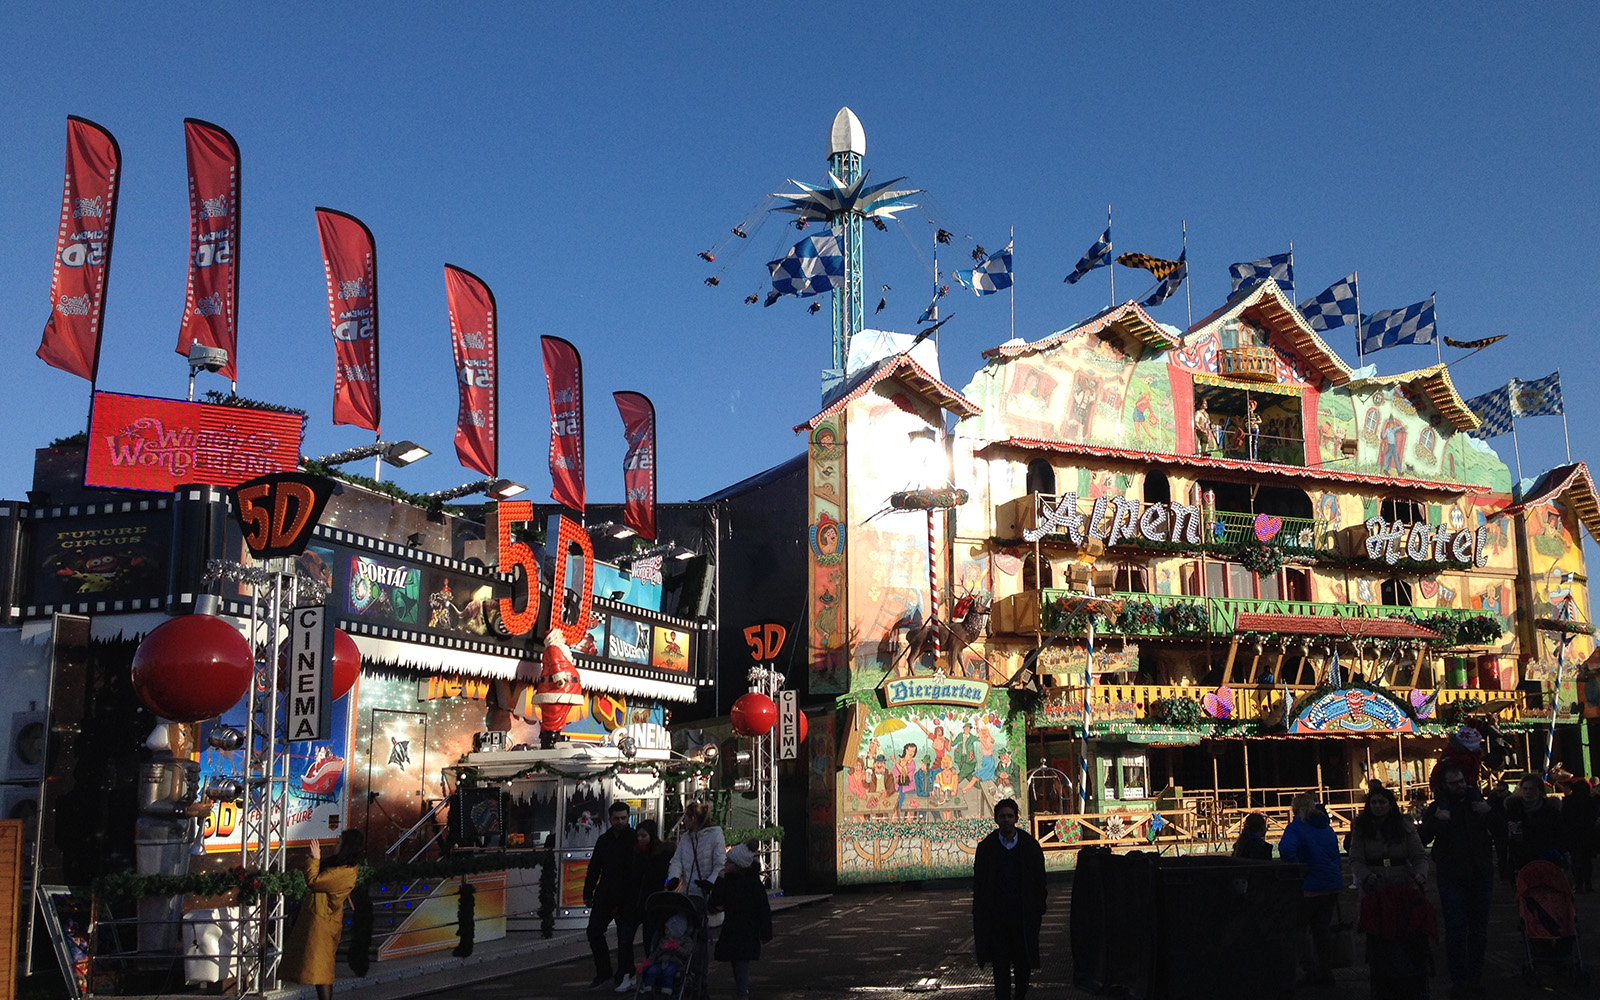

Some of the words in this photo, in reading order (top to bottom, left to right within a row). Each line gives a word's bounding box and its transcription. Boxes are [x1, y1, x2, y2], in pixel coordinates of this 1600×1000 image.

[56, 526, 148, 541] FUTURE
[237, 481, 315, 550] 5D
[1023, 491, 1202, 548] Alpen
[61, 536, 141, 549] CIRCUS
[1364, 515, 1490, 568] Hotel
[357, 560, 408, 588] PORTAL
[498, 500, 595, 646] 5D
[743, 623, 787, 661] 5D
[294, 609, 318, 738] CINEMA
[890, 681, 983, 703] Biergarten
[612, 722, 672, 750] CINEMA
[783, 691, 795, 758] CINEMA
